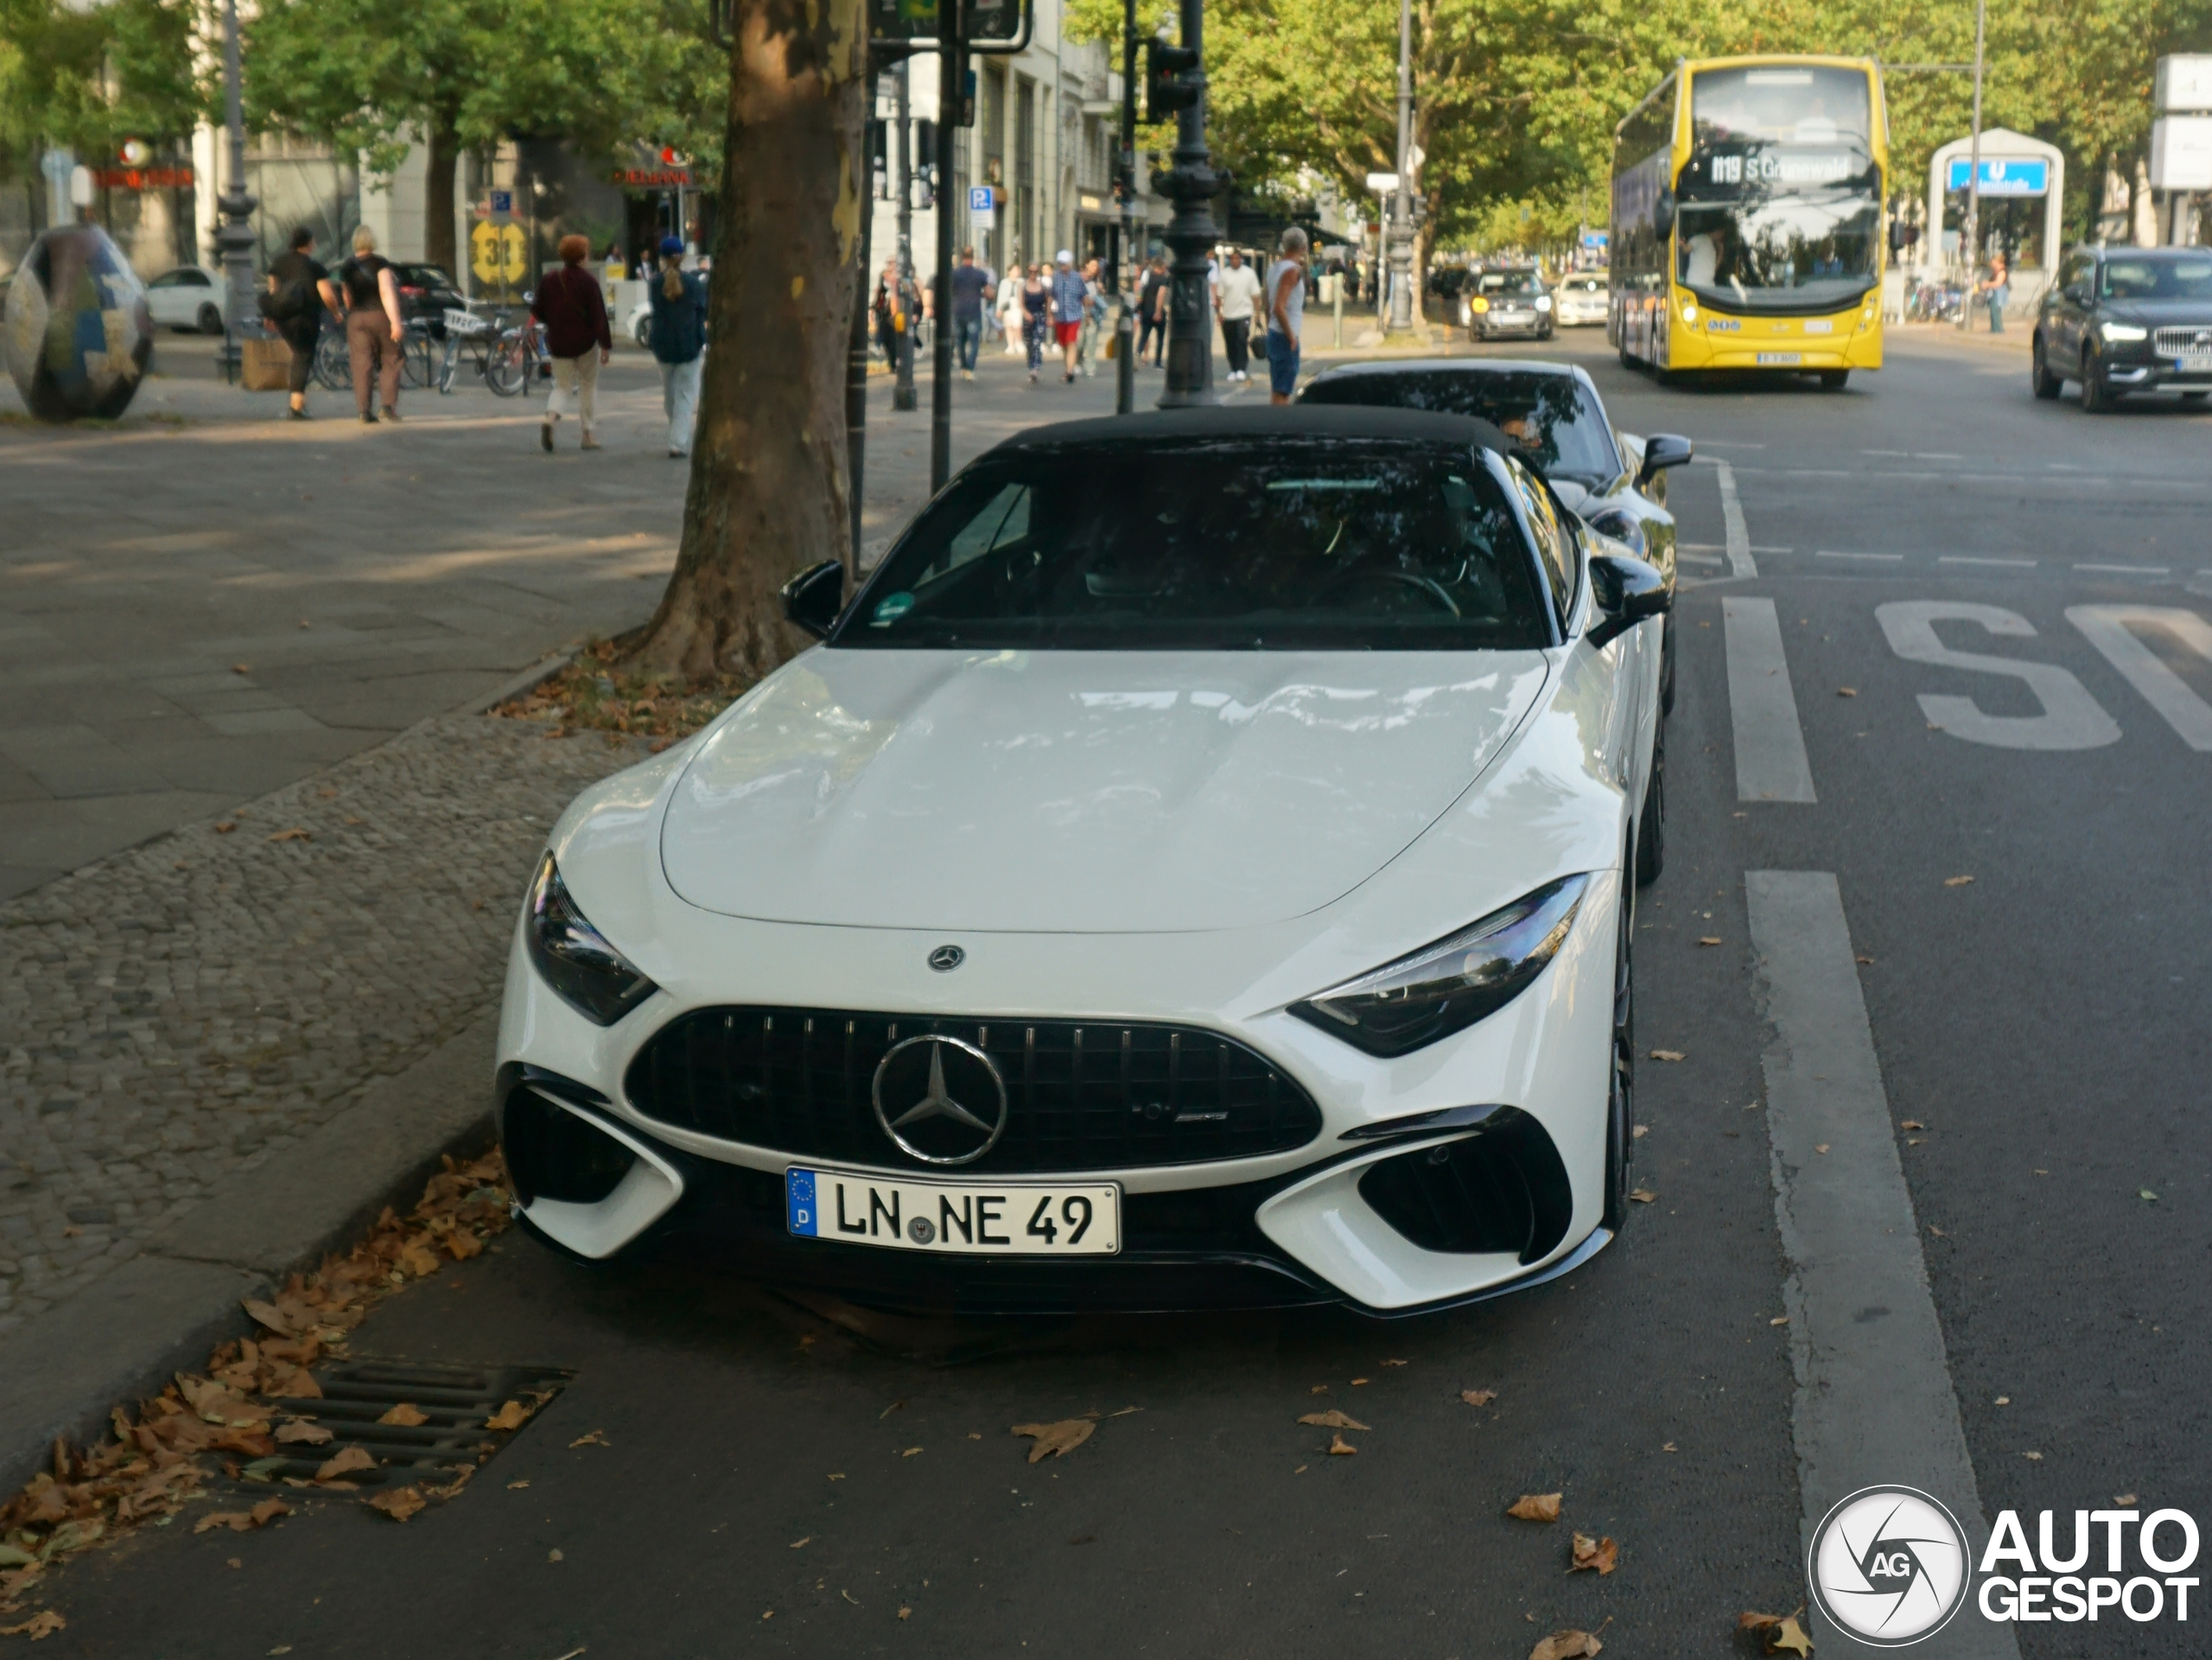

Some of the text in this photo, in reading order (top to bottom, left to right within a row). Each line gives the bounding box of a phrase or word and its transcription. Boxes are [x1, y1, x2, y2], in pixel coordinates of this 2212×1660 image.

[1712, 156, 1849, 183] M19 S Grunewald
[1990, 161, 2005, 180] U
[1960, 177, 2030, 192] landstraße
[973, 190, 987, 207] P
[797, 1209, 809, 1224] D
[836, 1182, 1093, 1245] LN NE 49
